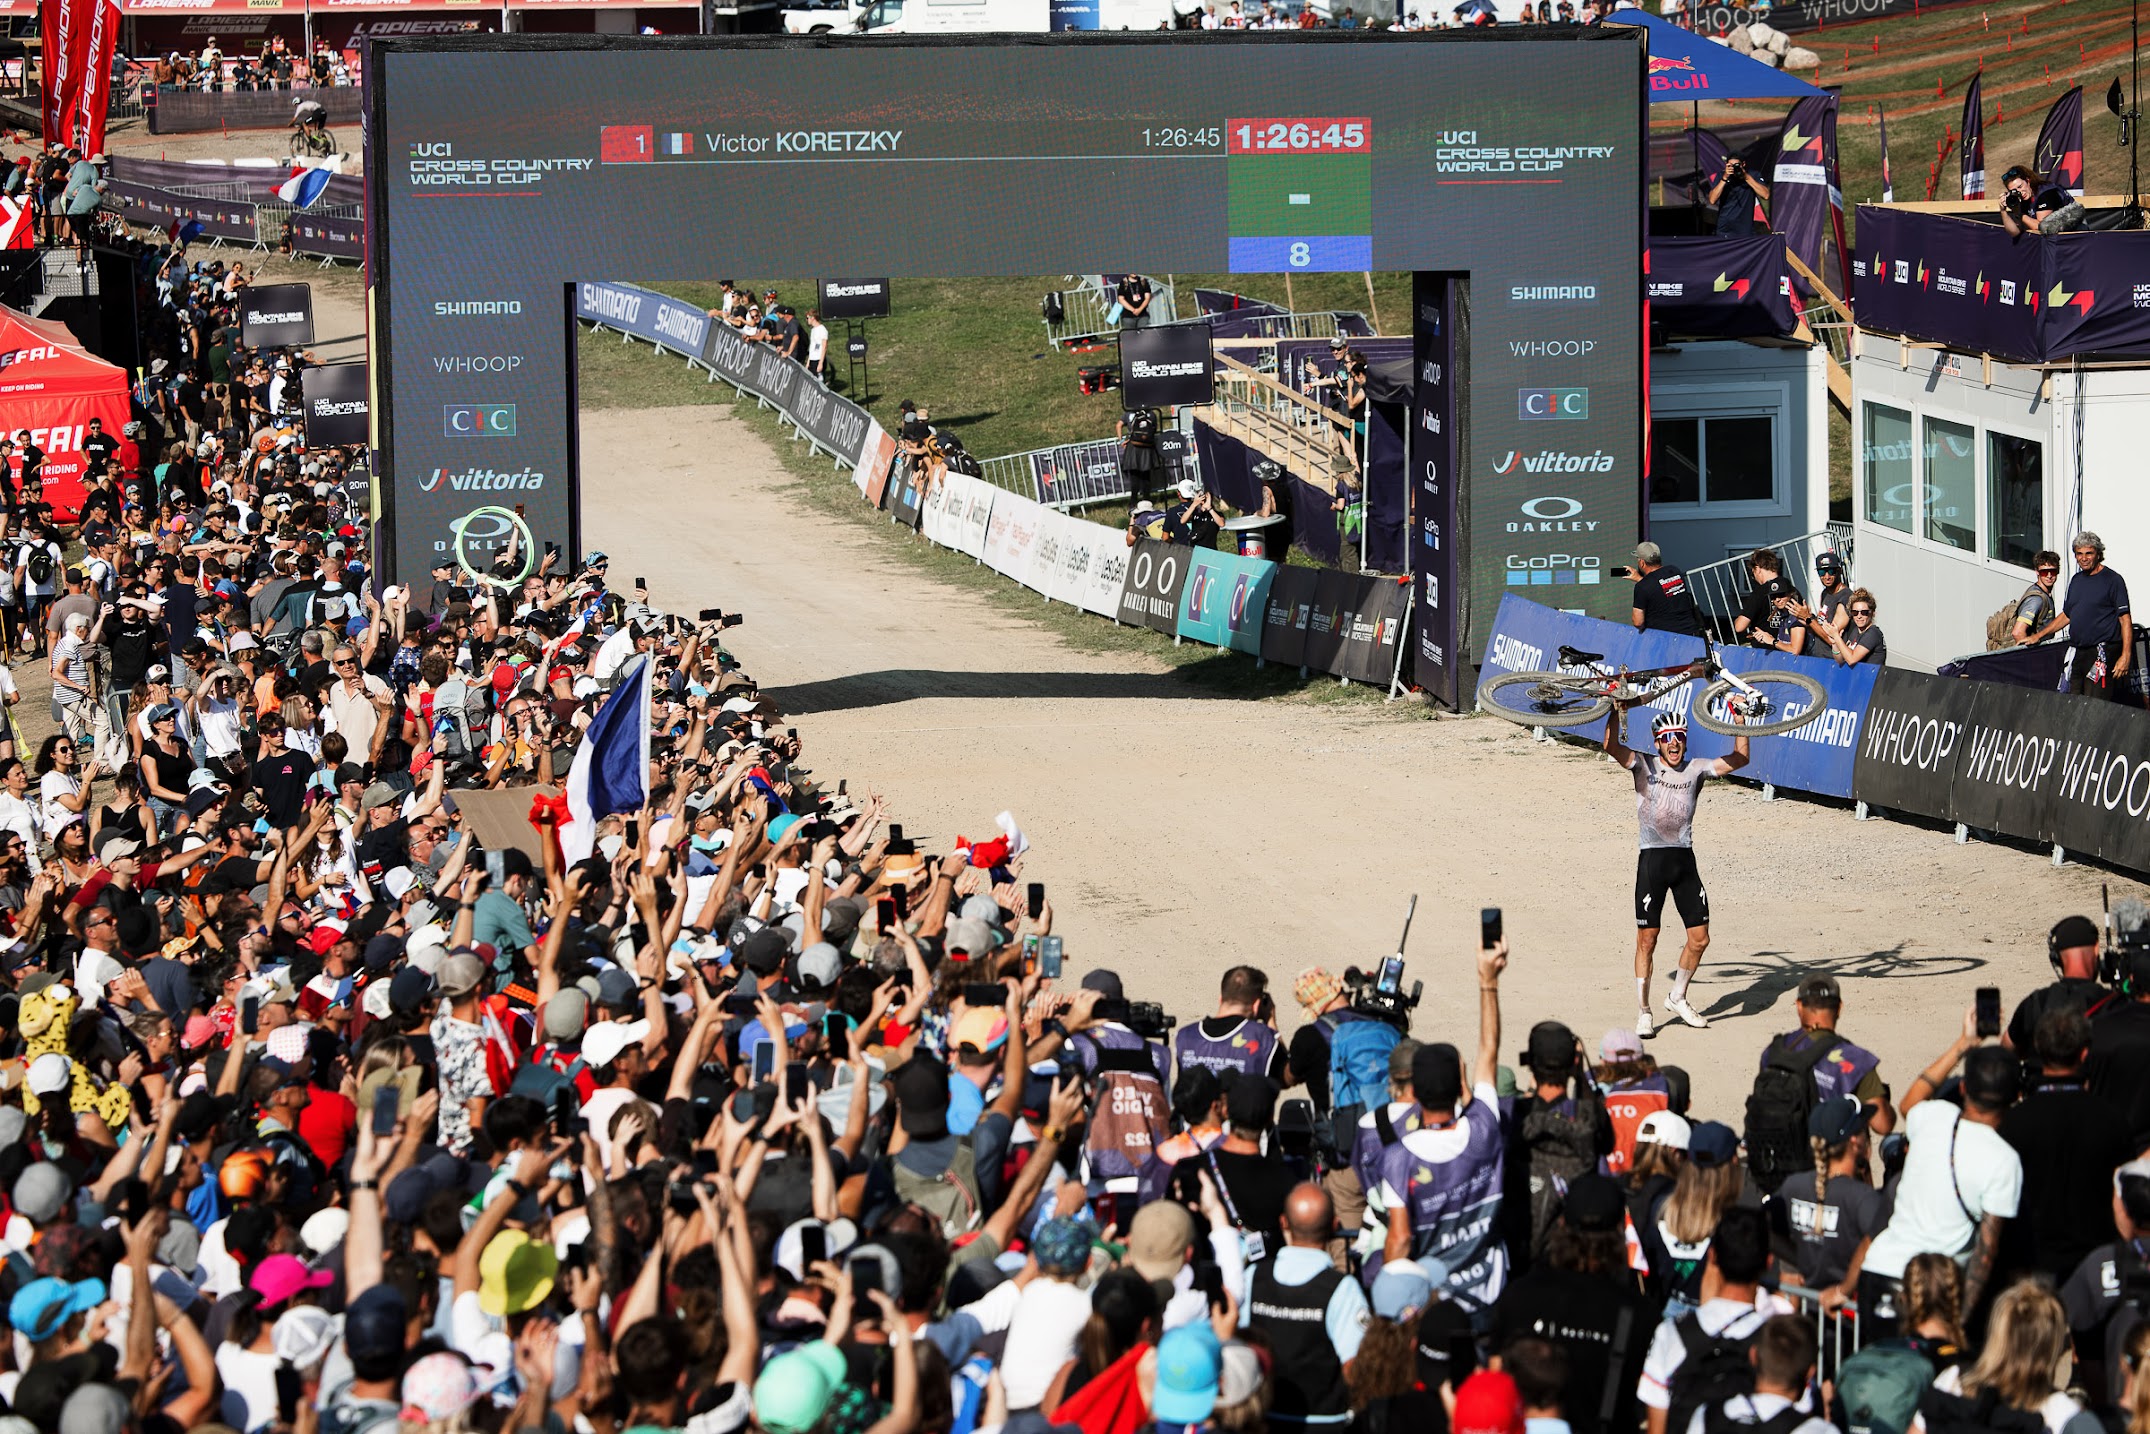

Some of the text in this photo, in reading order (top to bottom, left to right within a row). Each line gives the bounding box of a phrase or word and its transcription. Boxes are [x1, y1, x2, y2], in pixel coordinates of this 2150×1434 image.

[187, 16, 272, 25] LAPIERRE
[81, 3, 107, 158] SUPERIOR
[1650, 74, 1709, 90] Bull
[635, 135, 645, 153] 1
[706, 131, 902, 153] Victor KORETZKY
[1142, 128, 1220, 147] 1:26:45
[1236, 124, 1364, 149] 1:26:45
[1443, 131, 1477, 145] UCI
[417, 143, 451, 157] UCI
[1436, 147, 1614, 160] CROSS COUNTRY
[410, 158, 593, 172] CROSS COUNTRY
[1436, 161, 1563, 173] WORLD CUP
[410, 173, 541, 185] WORLD CUP
[1289, 242, 1311, 267] 8
[1512, 285, 1596, 300] SHIMANO
[435, 301, 522, 315] SHIMANO
[583, 284, 642, 324] SHIMANO
[654, 303, 704, 347] SHIMANO
[1, 346, 61, 367] EFAL
[712, 329, 755, 376] WHOOP
[1509, 340, 1595, 356] WHOOP
[433, 356, 522, 373] WHOOP
[1132, 363, 1180, 372] MOUNTAIN
[757, 352, 793, 397] WHOOP
[25, 383, 44, 391] RIDING
[314, 401, 366, 411] MOUNTAIN
[315, 408, 352, 416] WORLD
[796, 380, 827, 429] WHOOP
[1525, 393, 1581, 415] CIC
[452, 410, 508, 431] CIC
[829, 403, 863, 454] WHOOP
[1162, 441, 1181, 450] 20m
[45, 464, 78, 475] RIDING
[1522, 450, 1615, 473] vittoria
[349, 481, 368, 490] 20m
[450, 467, 544, 491] vittoria
[1425, 517, 1439, 535] GoPro
[1506, 521, 1599, 533] OAKLEY
[1506, 554, 1600, 568] GoPro
[1149, 596, 1174, 620] OAKLEY
[1490, 633, 1543, 671] SHIMANO
[1865, 707, 1957, 772] WHOOP
[1967, 724, 2056, 791] WHOOP
[2059, 741, 2150, 821] WHOO
